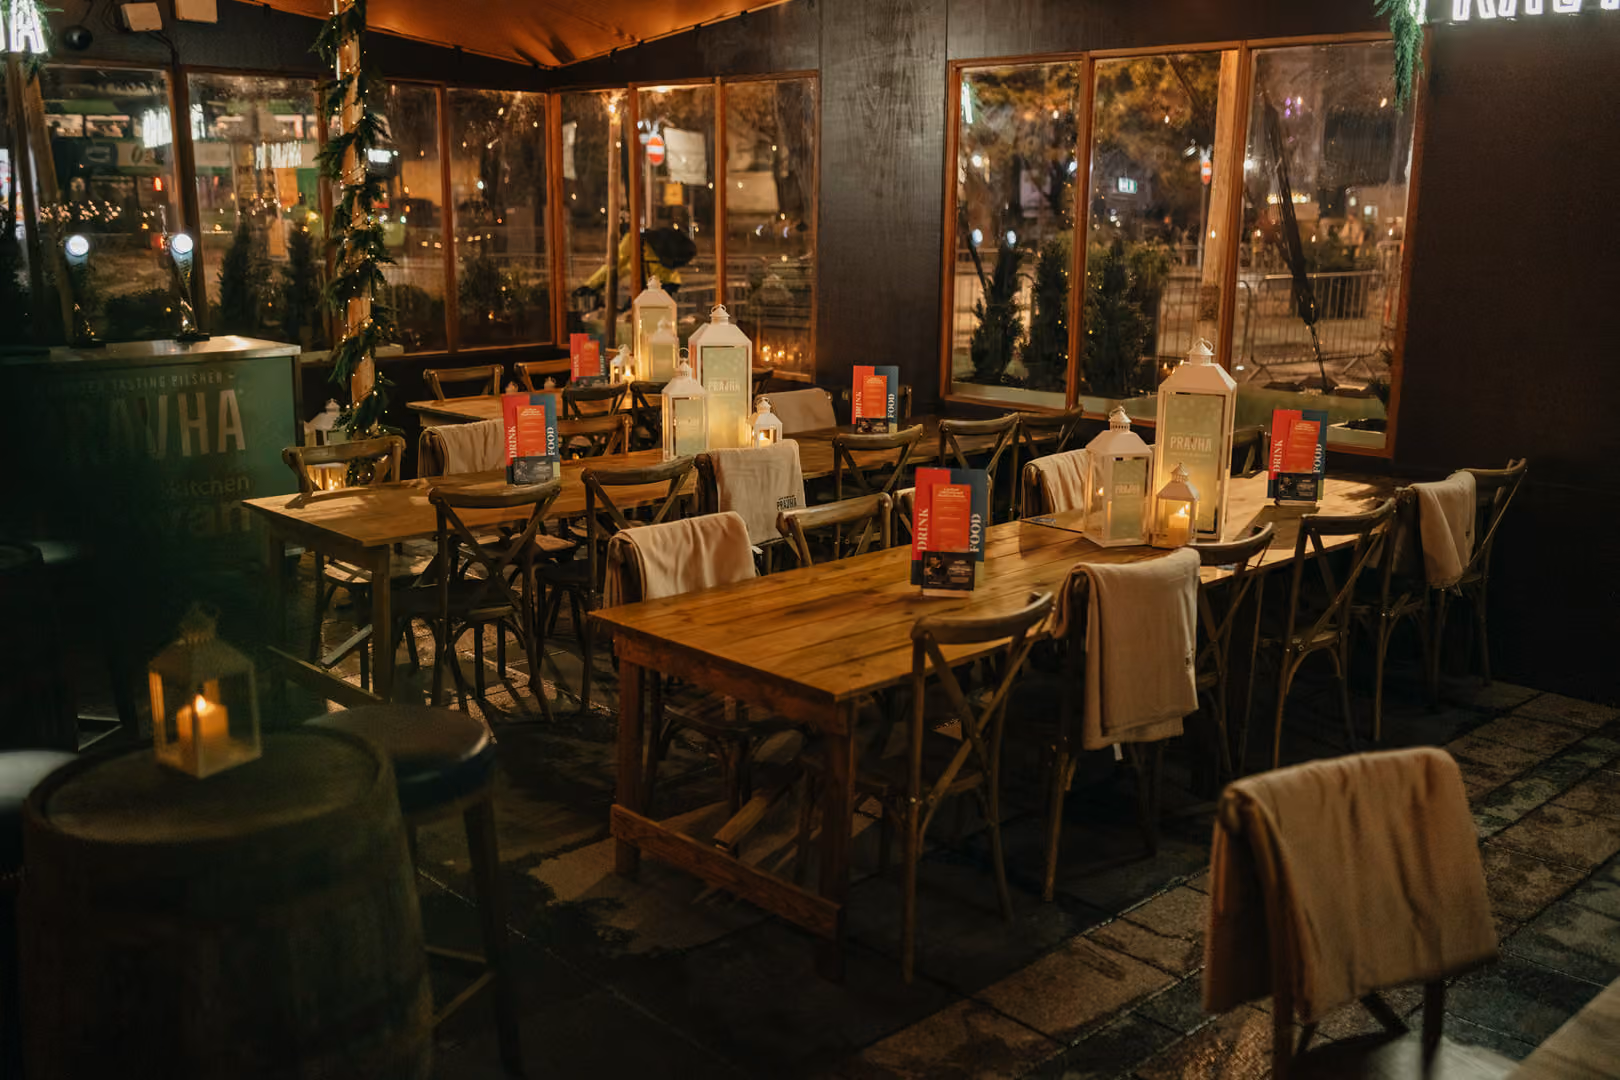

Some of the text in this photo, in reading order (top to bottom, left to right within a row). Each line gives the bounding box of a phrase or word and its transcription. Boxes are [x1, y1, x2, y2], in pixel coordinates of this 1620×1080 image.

[0, 0, 49, 54] A
[66, 389, 247, 462] AVHA
[507, 425, 518, 458] DRINK
[546, 426, 556, 456] FOOD
[1272, 439, 1284, 472] DRINK
[916, 508, 929, 552] DRINK
[969, 513, 982, 553] FOOD
